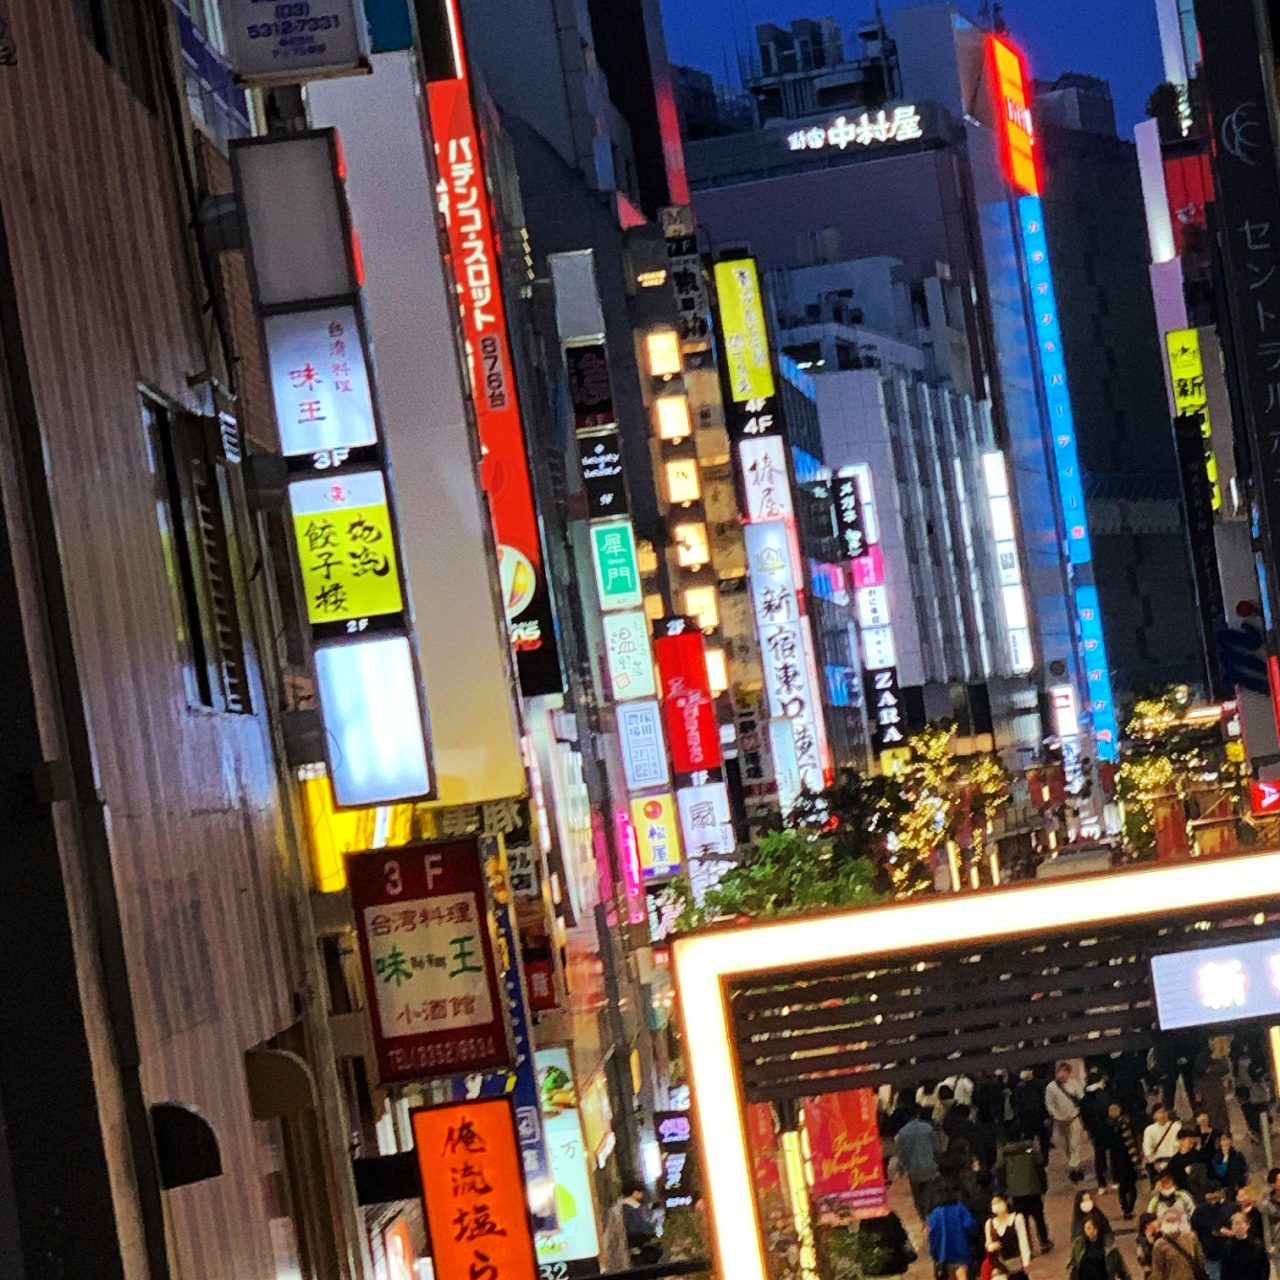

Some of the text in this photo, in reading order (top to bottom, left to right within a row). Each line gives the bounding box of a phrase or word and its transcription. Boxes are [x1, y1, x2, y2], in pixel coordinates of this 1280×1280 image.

[448, 136, 495, 331] パチンコ・スロット
[287, 362, 327, 425] 味王
[744, 416, 774, 434] 4F
[313, 449, 349, 470] 3F
[344, 620, 369, 632] 2F
[874, 671, 903, 742] ZARA
[371, 902, 473, 936] 台湾料理
[376, 936, 482, 986] 味 王
